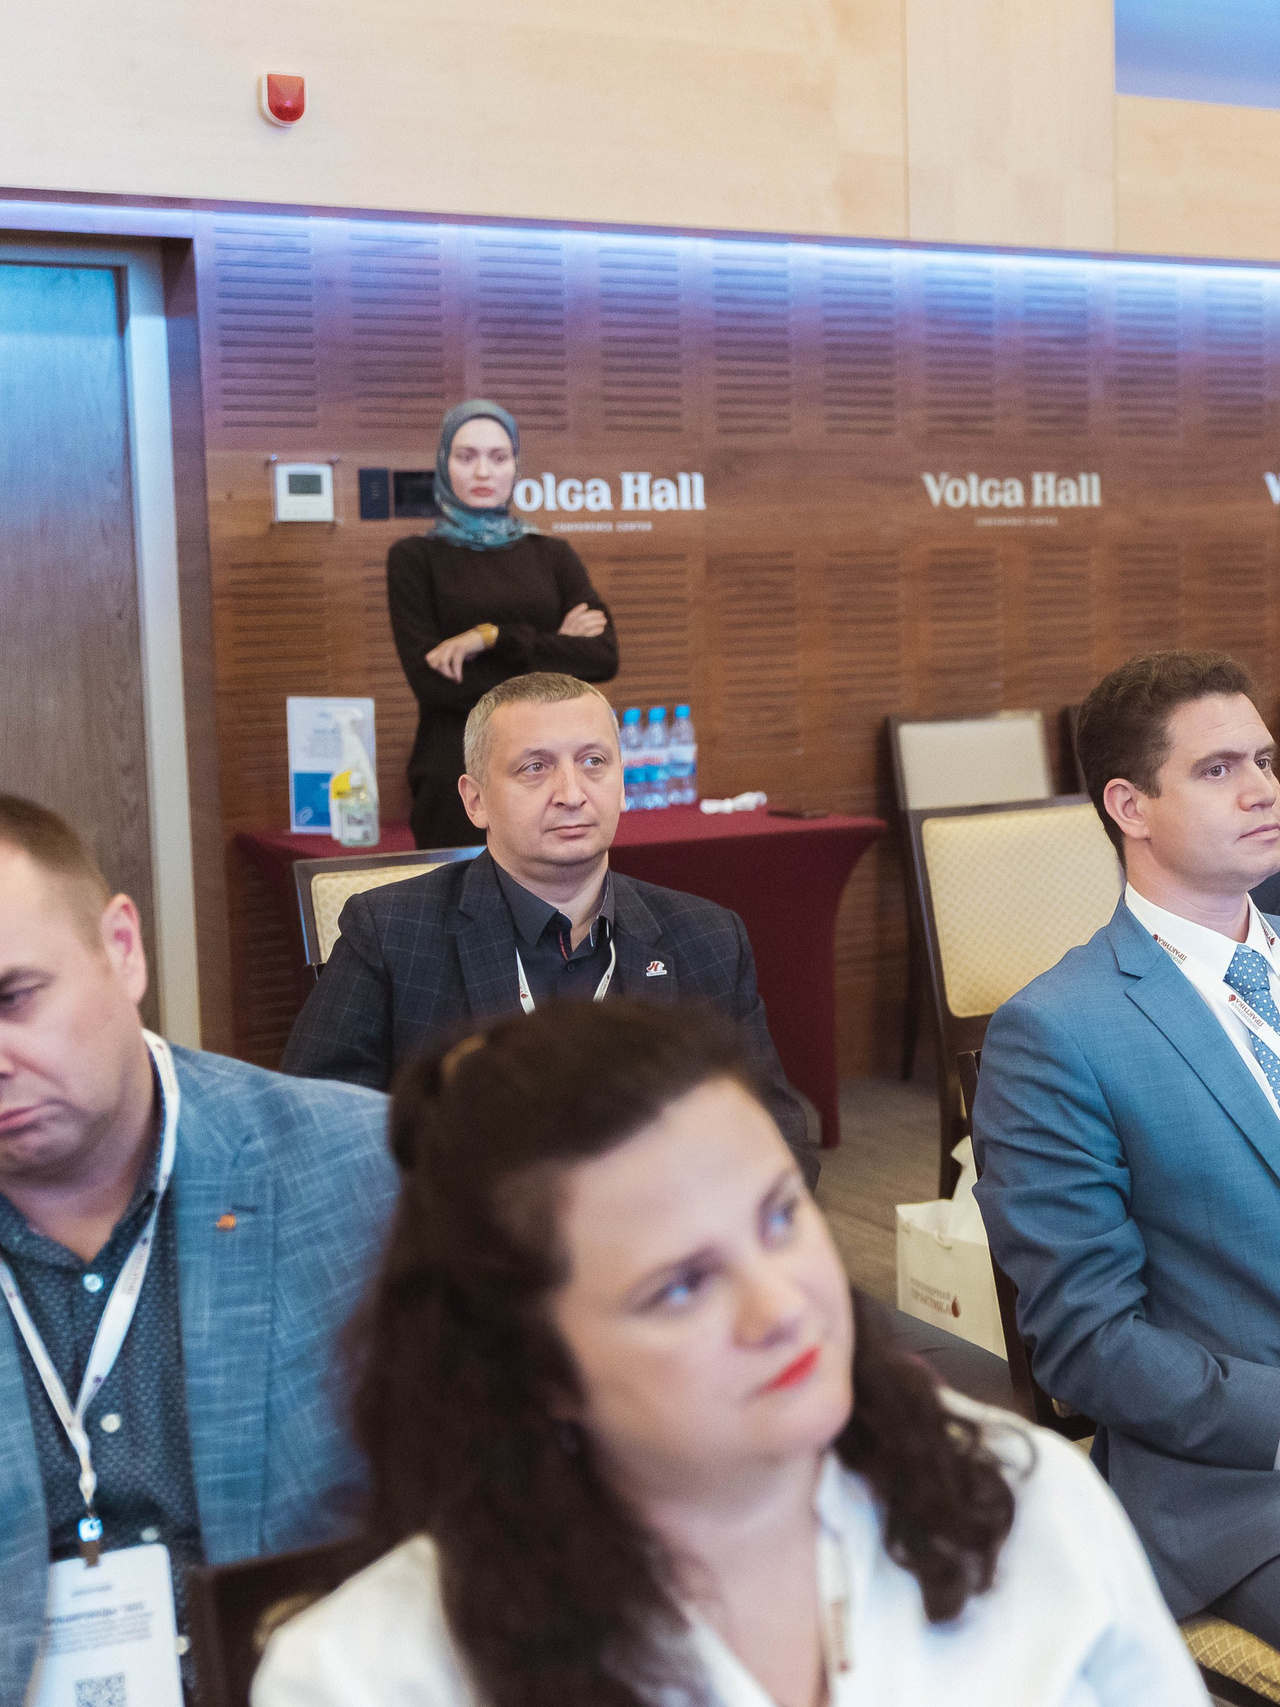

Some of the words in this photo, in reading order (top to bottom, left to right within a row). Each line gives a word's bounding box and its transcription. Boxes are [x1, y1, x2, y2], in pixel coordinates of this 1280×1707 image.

[512, 472, 613, 512] olga
[620, 472, 706, 512] Hall
[922, 471, 1026, 508] Volga
[1031, 471, 1102, 508] Hall
[1158, 936, 1187, 962] ПРАКТИКА
[1235, 998, 1264, 1028] ПРАКТИКА
